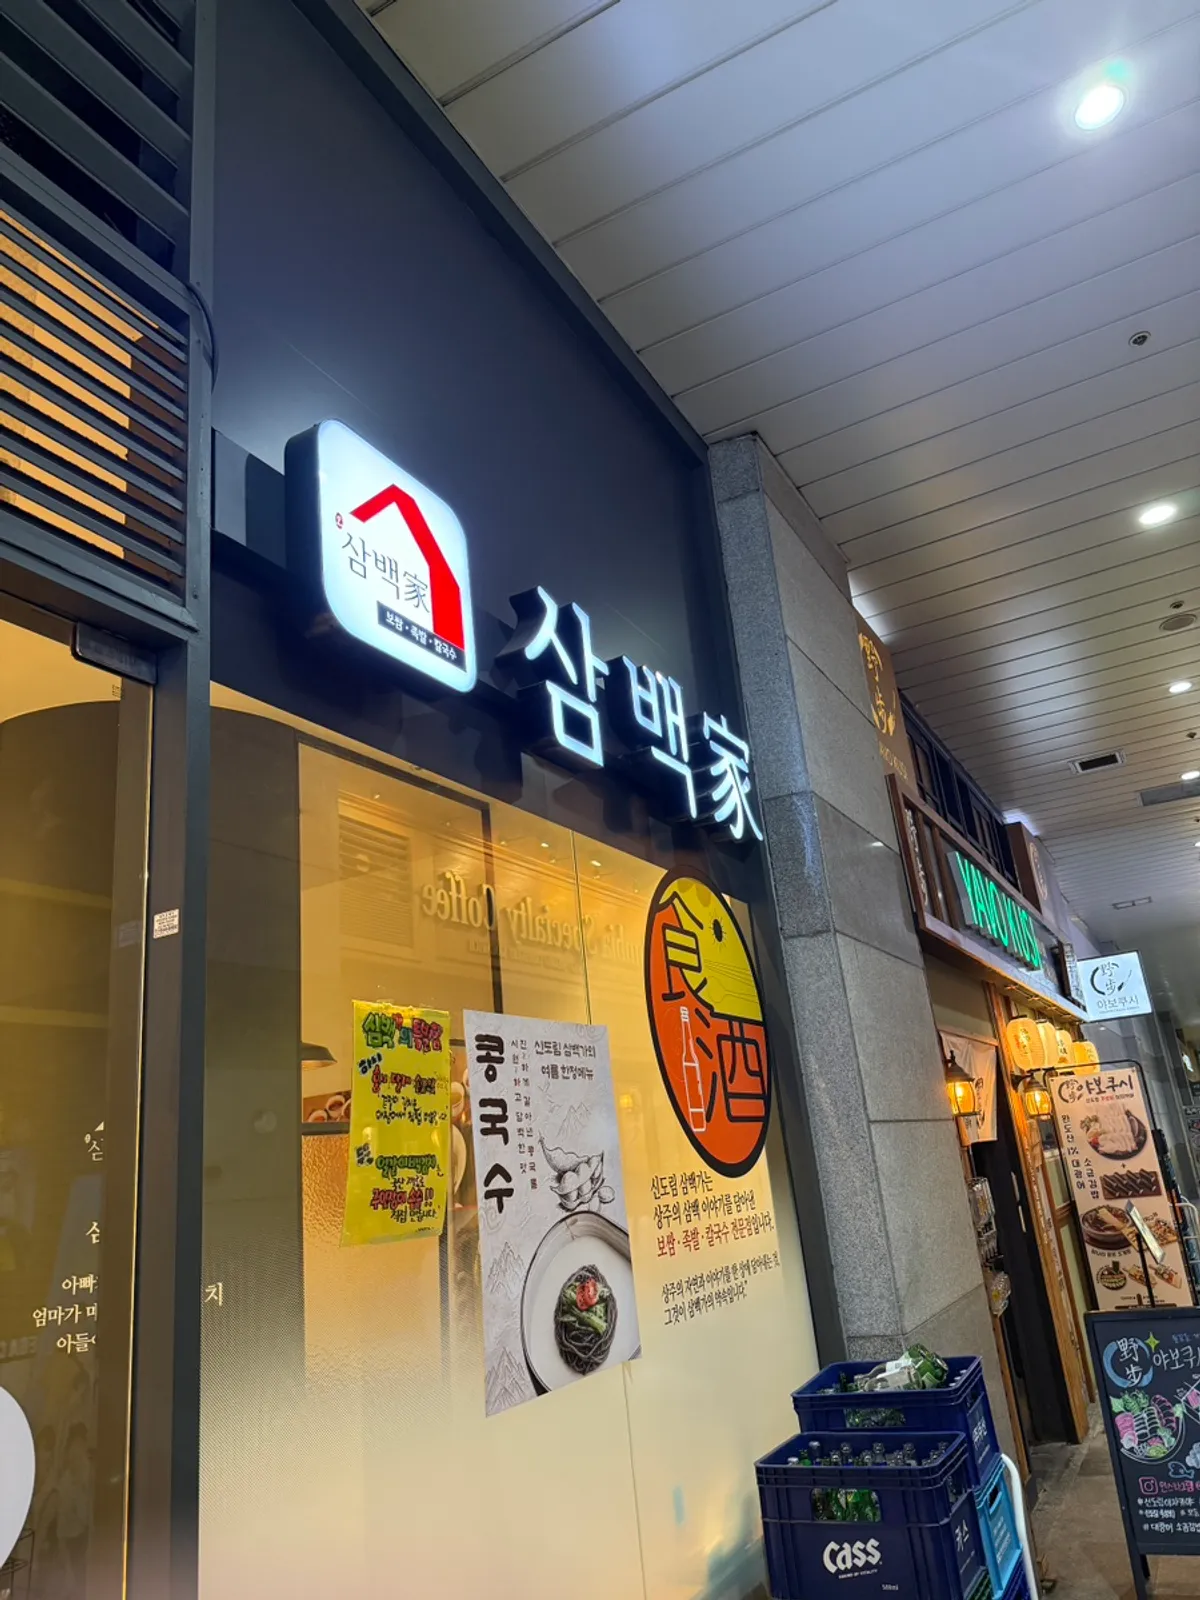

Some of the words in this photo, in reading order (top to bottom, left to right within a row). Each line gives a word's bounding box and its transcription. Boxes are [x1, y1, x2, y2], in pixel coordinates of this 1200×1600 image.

[341, 532, 430, 613] 삼백家
[386, 610, 404, 632] 보쌈
[411, 626, 428, 646] 족발
[434, 637, 458, 661] 칼국수
[522, 584, 764, 842] 삼백家
[534, 1040, 562, 1057] 신도림
[541, 1063, 560, 1080] 여름
[1077, 1074, 1134, 1096] 야보쿠시
[475, 1033, 515, 1214] 콩국수
[650, 1173, 679, 1200] 신도림
[679, 1170, 714, 1196] 삼백가는
[653, 1201, 682, 1230] 상주의
[682, 1198, 702, 1224] 삼백
[701, 1193, 733, 1220] 이야기를
[657, 1231, 676, 1258] 보쌈
[682, 1227, 700, 1252] 족발
[705, 1221, 730, 1248] 칼국수
[661, 1279, 685, 1305] 상주의
[32, 1304, 82, 1327] 엄마가
[664, 1301, 688, 1326] 그것이
[56, 1334, 97, 1354] 아들
[1153, 1345, 1200, 1371] 야보쿠
[822, 1537, 881, 1574] Cass
